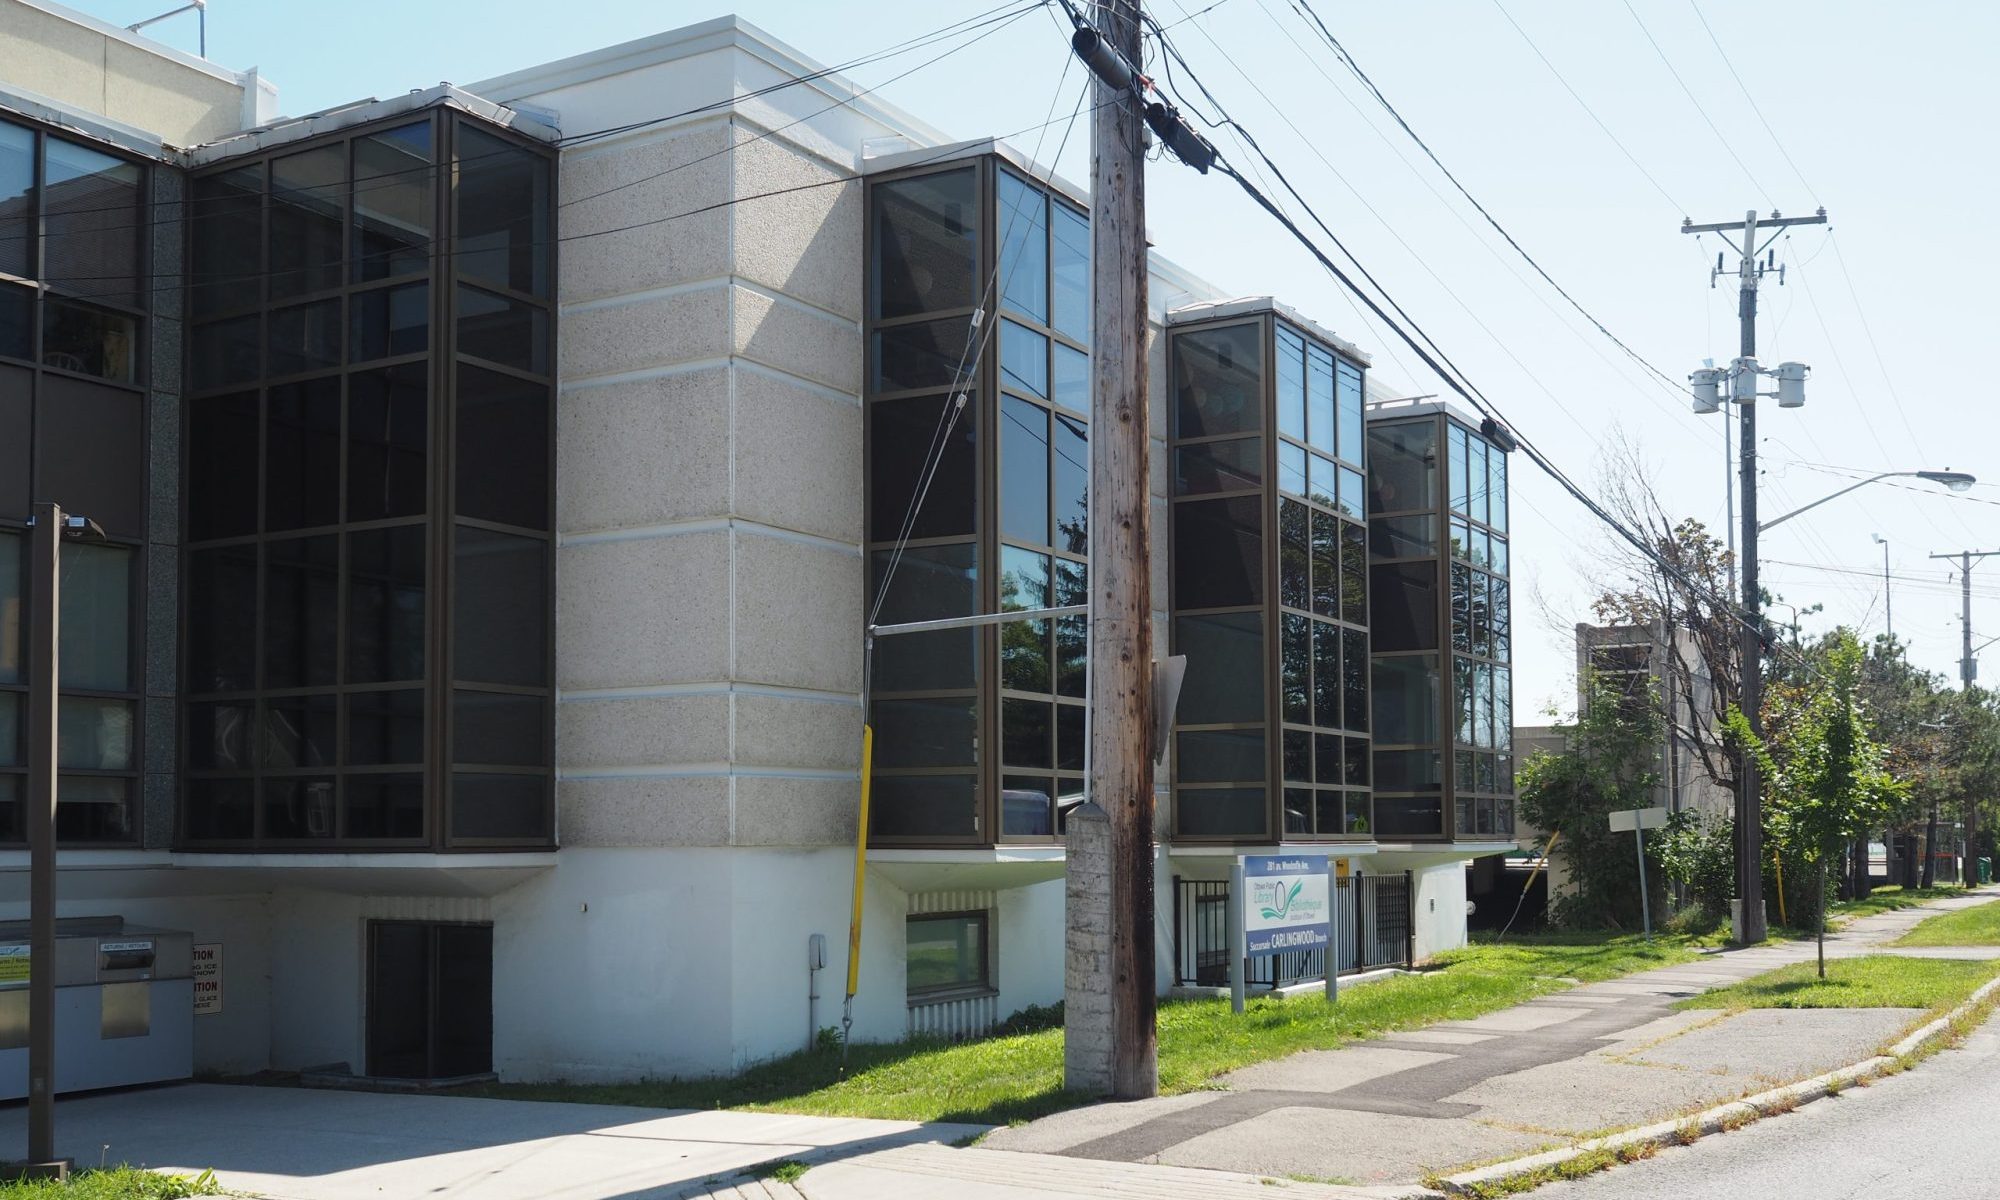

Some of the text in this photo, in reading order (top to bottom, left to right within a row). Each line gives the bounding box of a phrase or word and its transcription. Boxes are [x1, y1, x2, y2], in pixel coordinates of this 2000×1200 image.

[1254, 891, 1273, 904] Library
[1250, 940, 1271, 951] Succursale
[1271, 930, 1315, 948] CARLINGWOOD
[193, 950, 214, 961] TION
